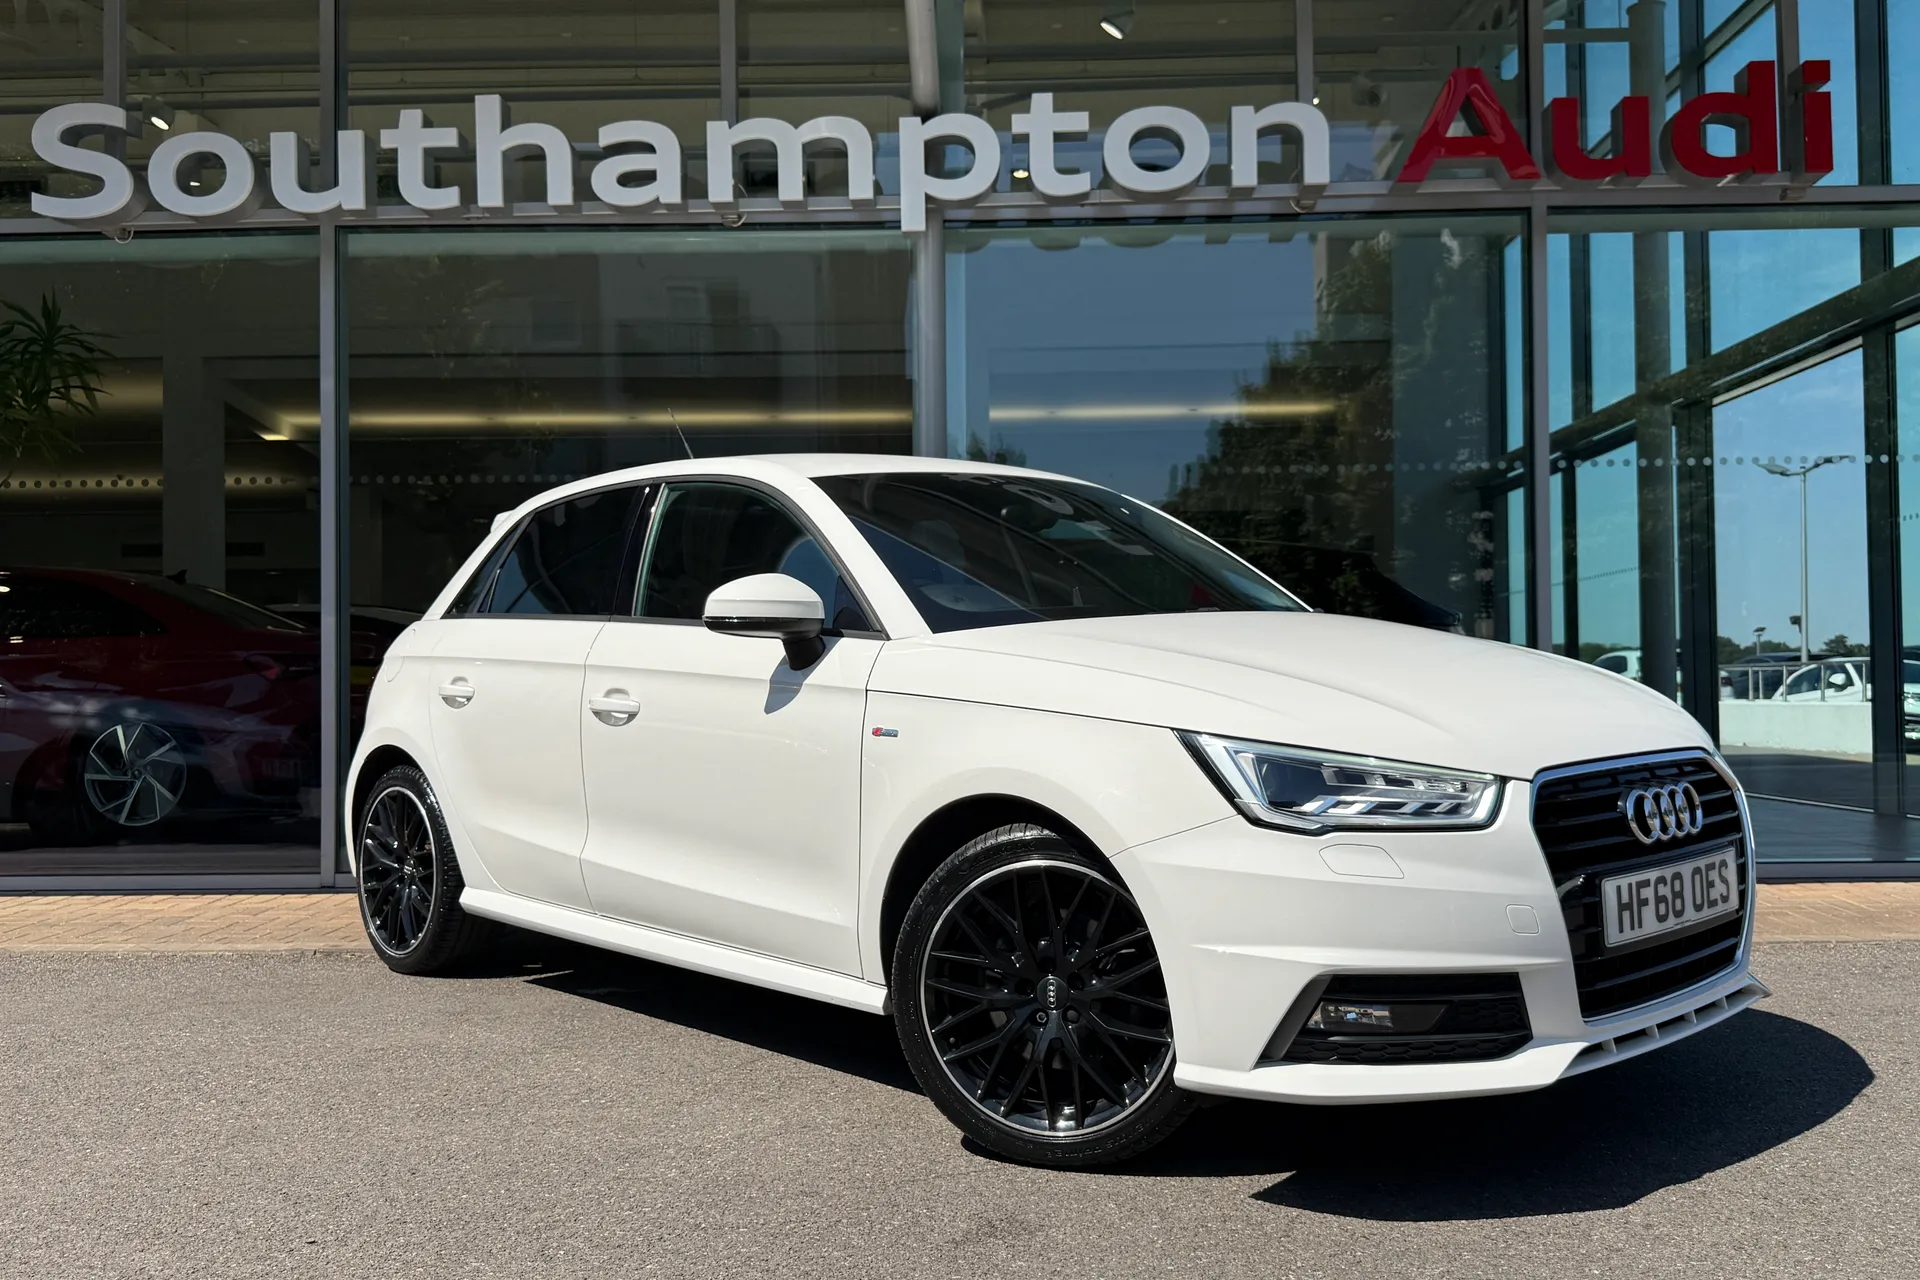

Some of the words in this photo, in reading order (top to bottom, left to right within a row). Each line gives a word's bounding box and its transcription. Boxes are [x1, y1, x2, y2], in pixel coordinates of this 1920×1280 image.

[31, 92, 1330, 232] Southampton
[1396, 60, 1833, 184] Audi
[1616, 871, 1686, 934] HF68
[1691, 858, 1731, 912] OES
